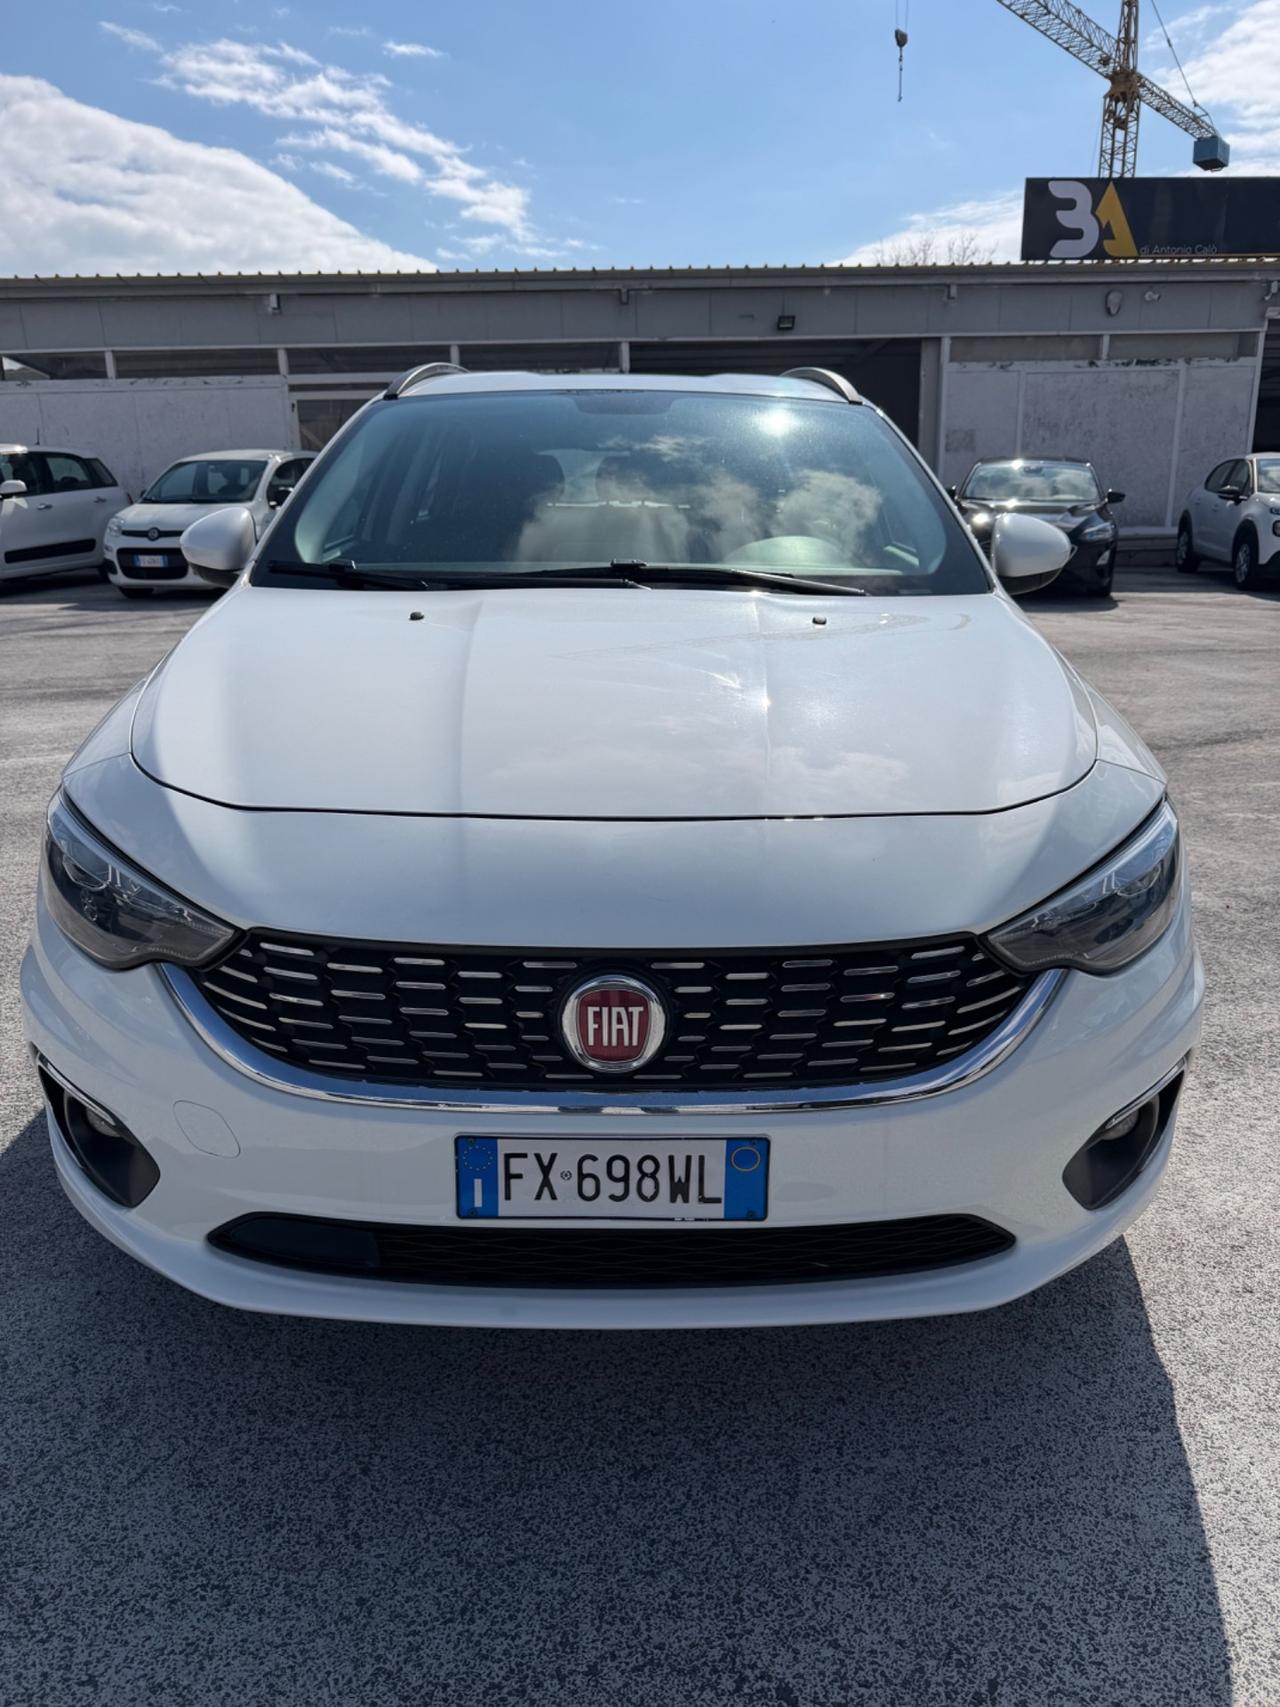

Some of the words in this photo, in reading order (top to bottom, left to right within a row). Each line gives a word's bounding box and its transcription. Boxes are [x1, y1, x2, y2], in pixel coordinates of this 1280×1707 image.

[1140, 244, 1150, 254] di
[1152, 244, 1192, 254] Antonio
[587, 1006, 644, 1047] FIAT
